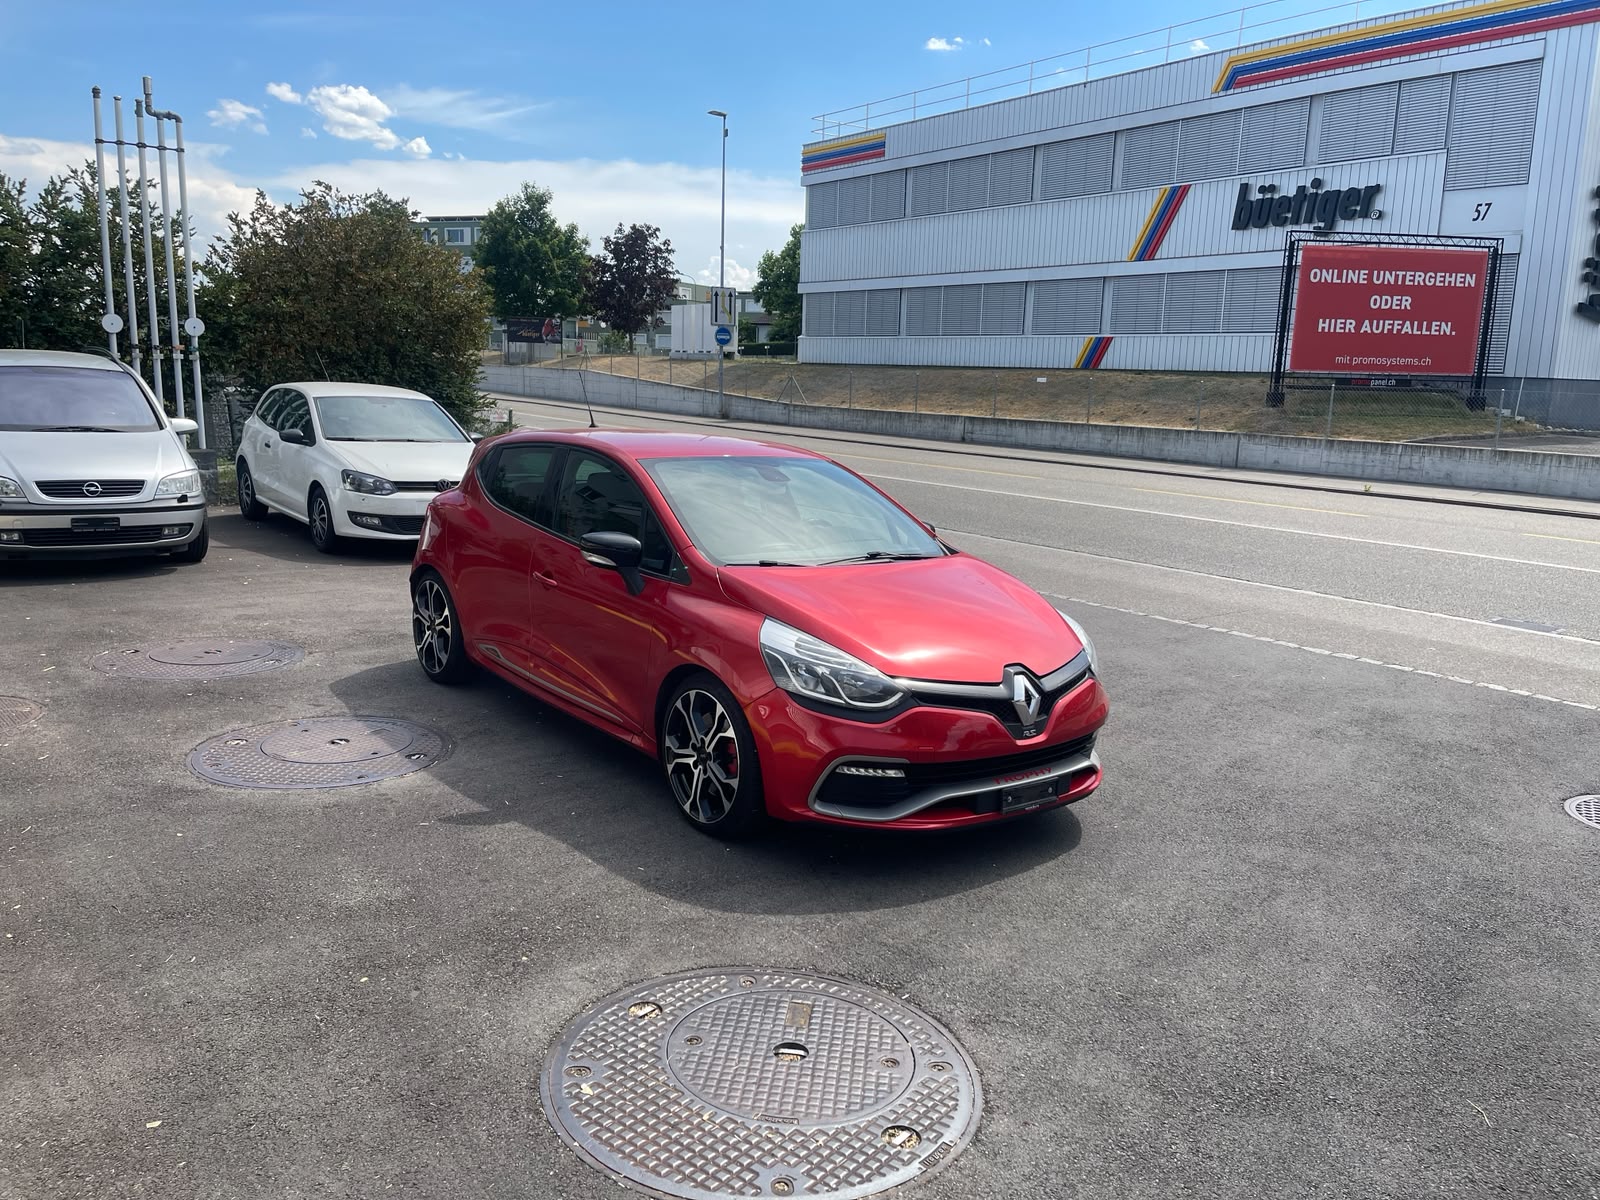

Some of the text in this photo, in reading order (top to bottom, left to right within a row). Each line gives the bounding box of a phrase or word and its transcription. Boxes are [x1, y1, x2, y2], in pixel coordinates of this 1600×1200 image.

[1231, 178, 1381, 232] büetiger
[1472, 202, 1493, 222] 57
[1309, 268, 1476, 287] ONLINE UNTERGEHEN
[1369, 295, 1412, 310] ODER
[1317, 318, 1456, 336] HIER AUFFALLEN.
[1335, 355, 1432, 366] mit promosystems.ch
[993, 768, 1052, 784] TROPHY
